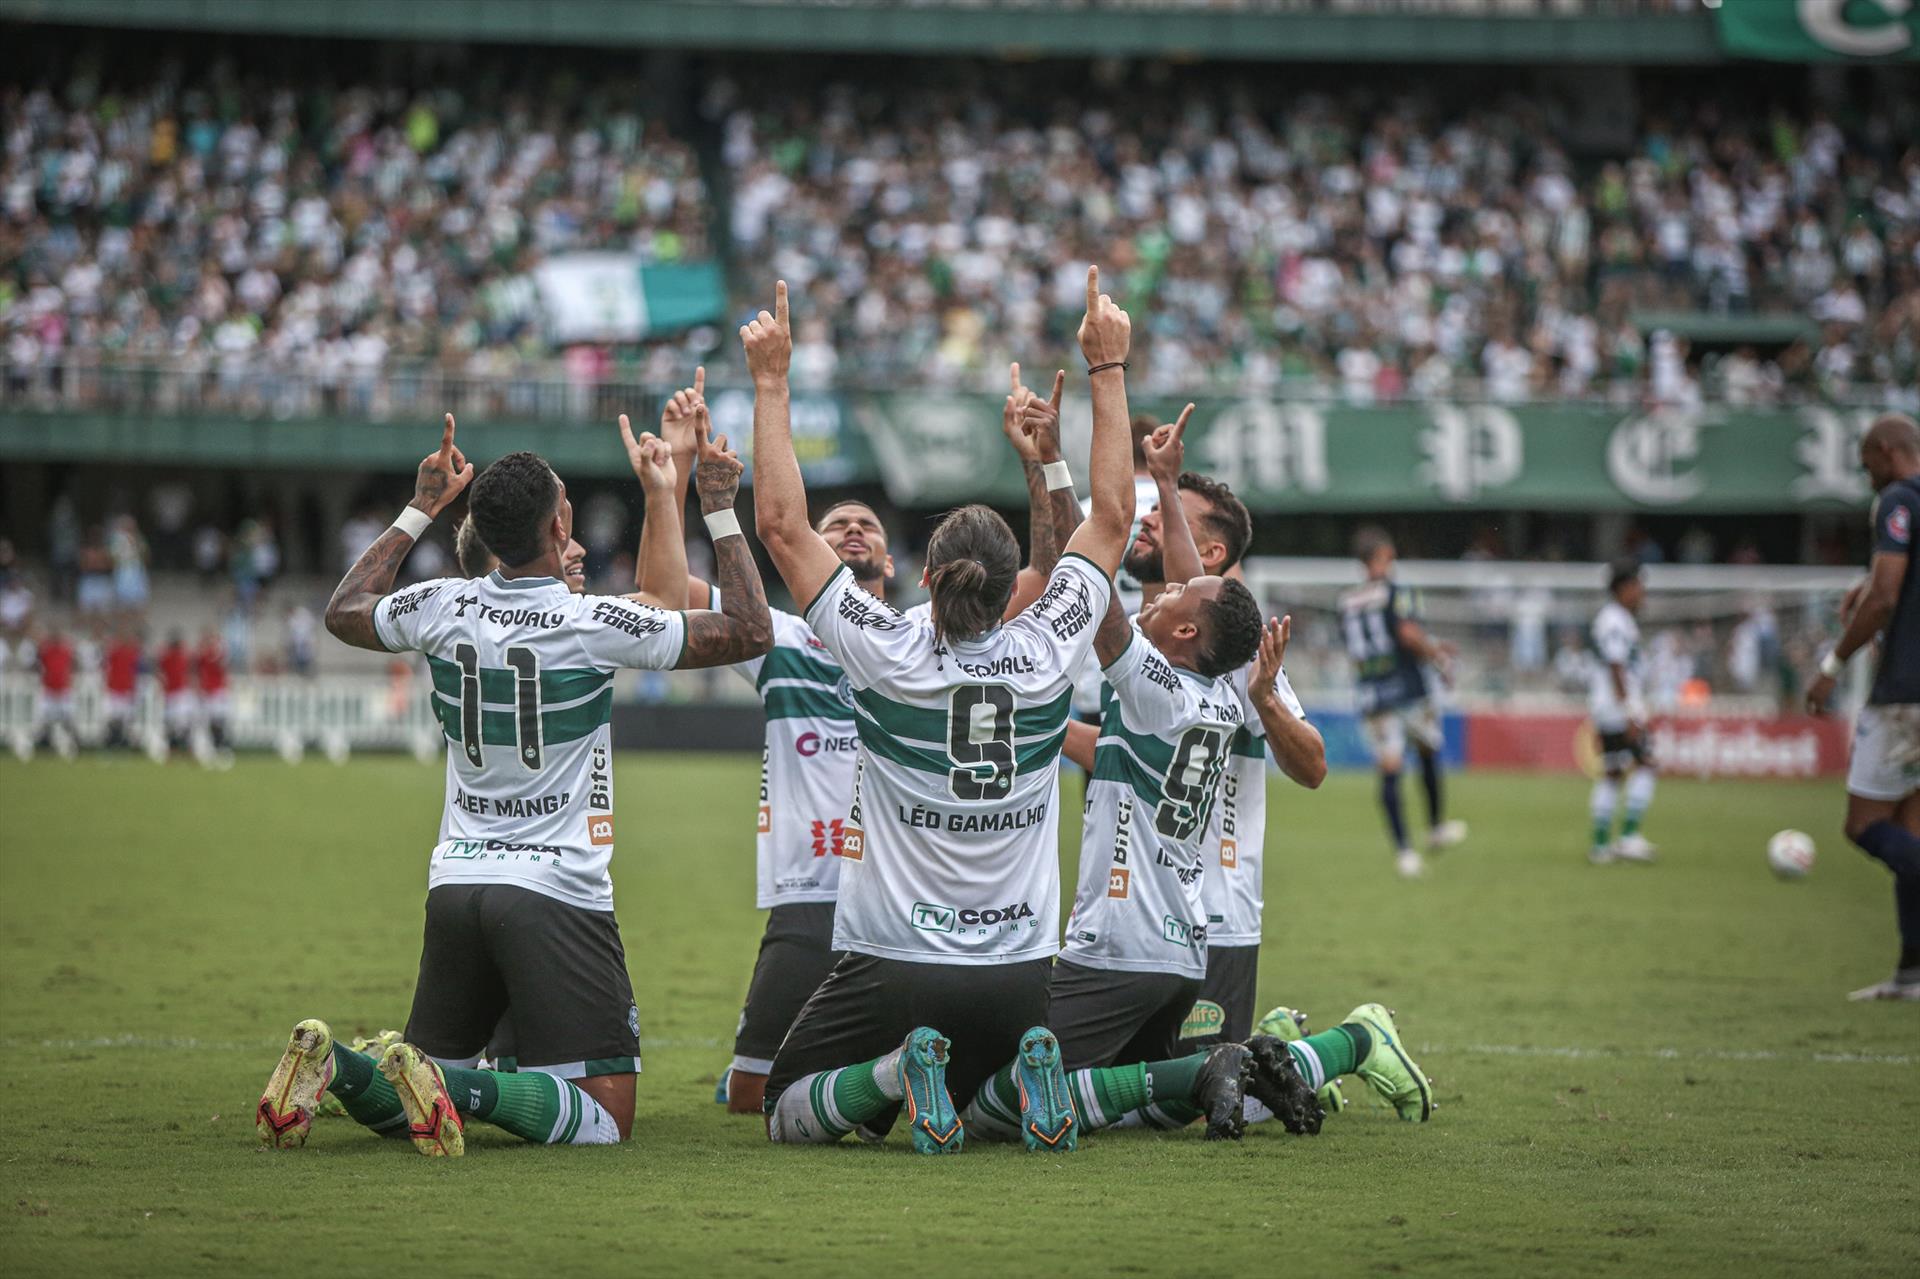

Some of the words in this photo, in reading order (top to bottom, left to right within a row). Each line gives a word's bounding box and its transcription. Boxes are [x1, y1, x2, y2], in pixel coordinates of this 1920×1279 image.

[478, 603, 565, 629] TEQUALY
[592, 610, 642, 639] TORK
[595, 602, 641, 622] PRO
[839, 600, 866, 631] ORK
[1051, 602, 1081, 634] PRO
[1057, 611, 1093, 642] TORK
[956, 654, 1035, 679] EQUALY
[1140, 664, 1175, 694] TORK
[453, 643, 545, 770] 11
[947, 684, 1018, 801] 9
[589, 748, 611, 810] Bitci
[454, 788, 490, 815] ALEF
[494, 792, 570, 818] MANGA
[900, 804, 940, 830] LÉO
[947, 803, 1046, 833] GAMALHO
[1223, 775, 1239, 836] Bitci
[451, 841, 478, 854] TV
[480, 853, 561, 868] PRIME
[918, 907, 951, 927] TV
[958, 902, 1035, 926] COXA
[957, 919, 1040, 936] PRIME
[1167, 921, 1186, 939] TV
